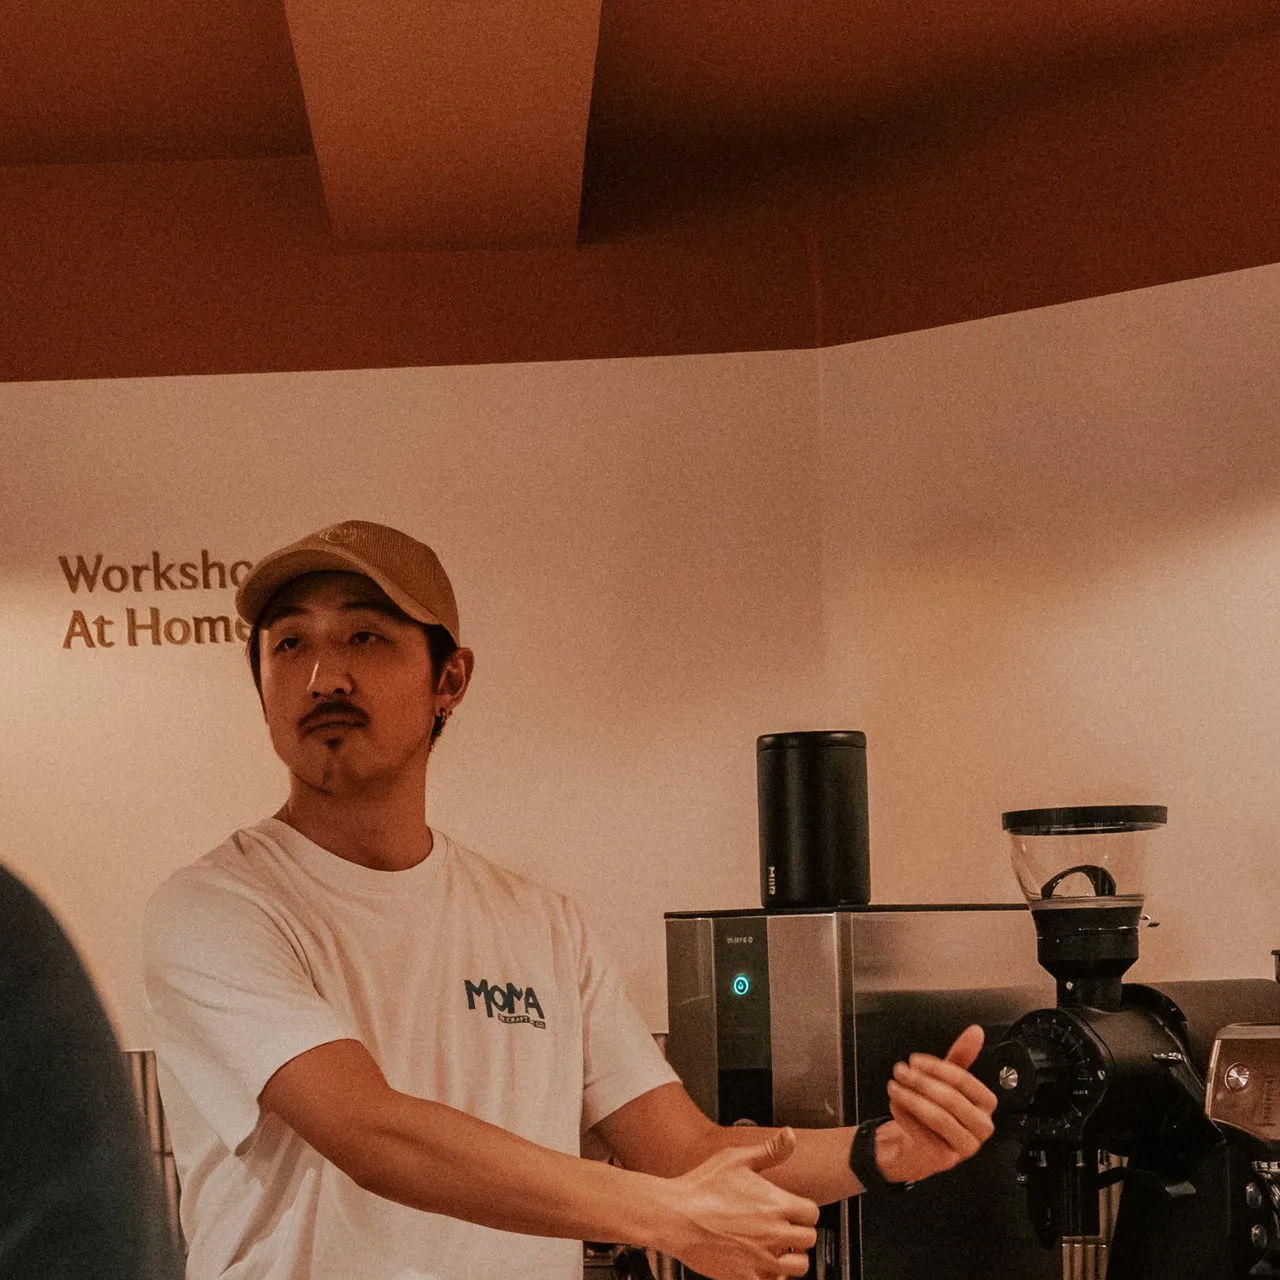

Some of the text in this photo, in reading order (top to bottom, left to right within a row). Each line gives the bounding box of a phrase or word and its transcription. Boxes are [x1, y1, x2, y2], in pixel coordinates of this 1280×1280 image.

[57, 550, 253, 594] Worksho
[61, 606, 252, 650] At Home
